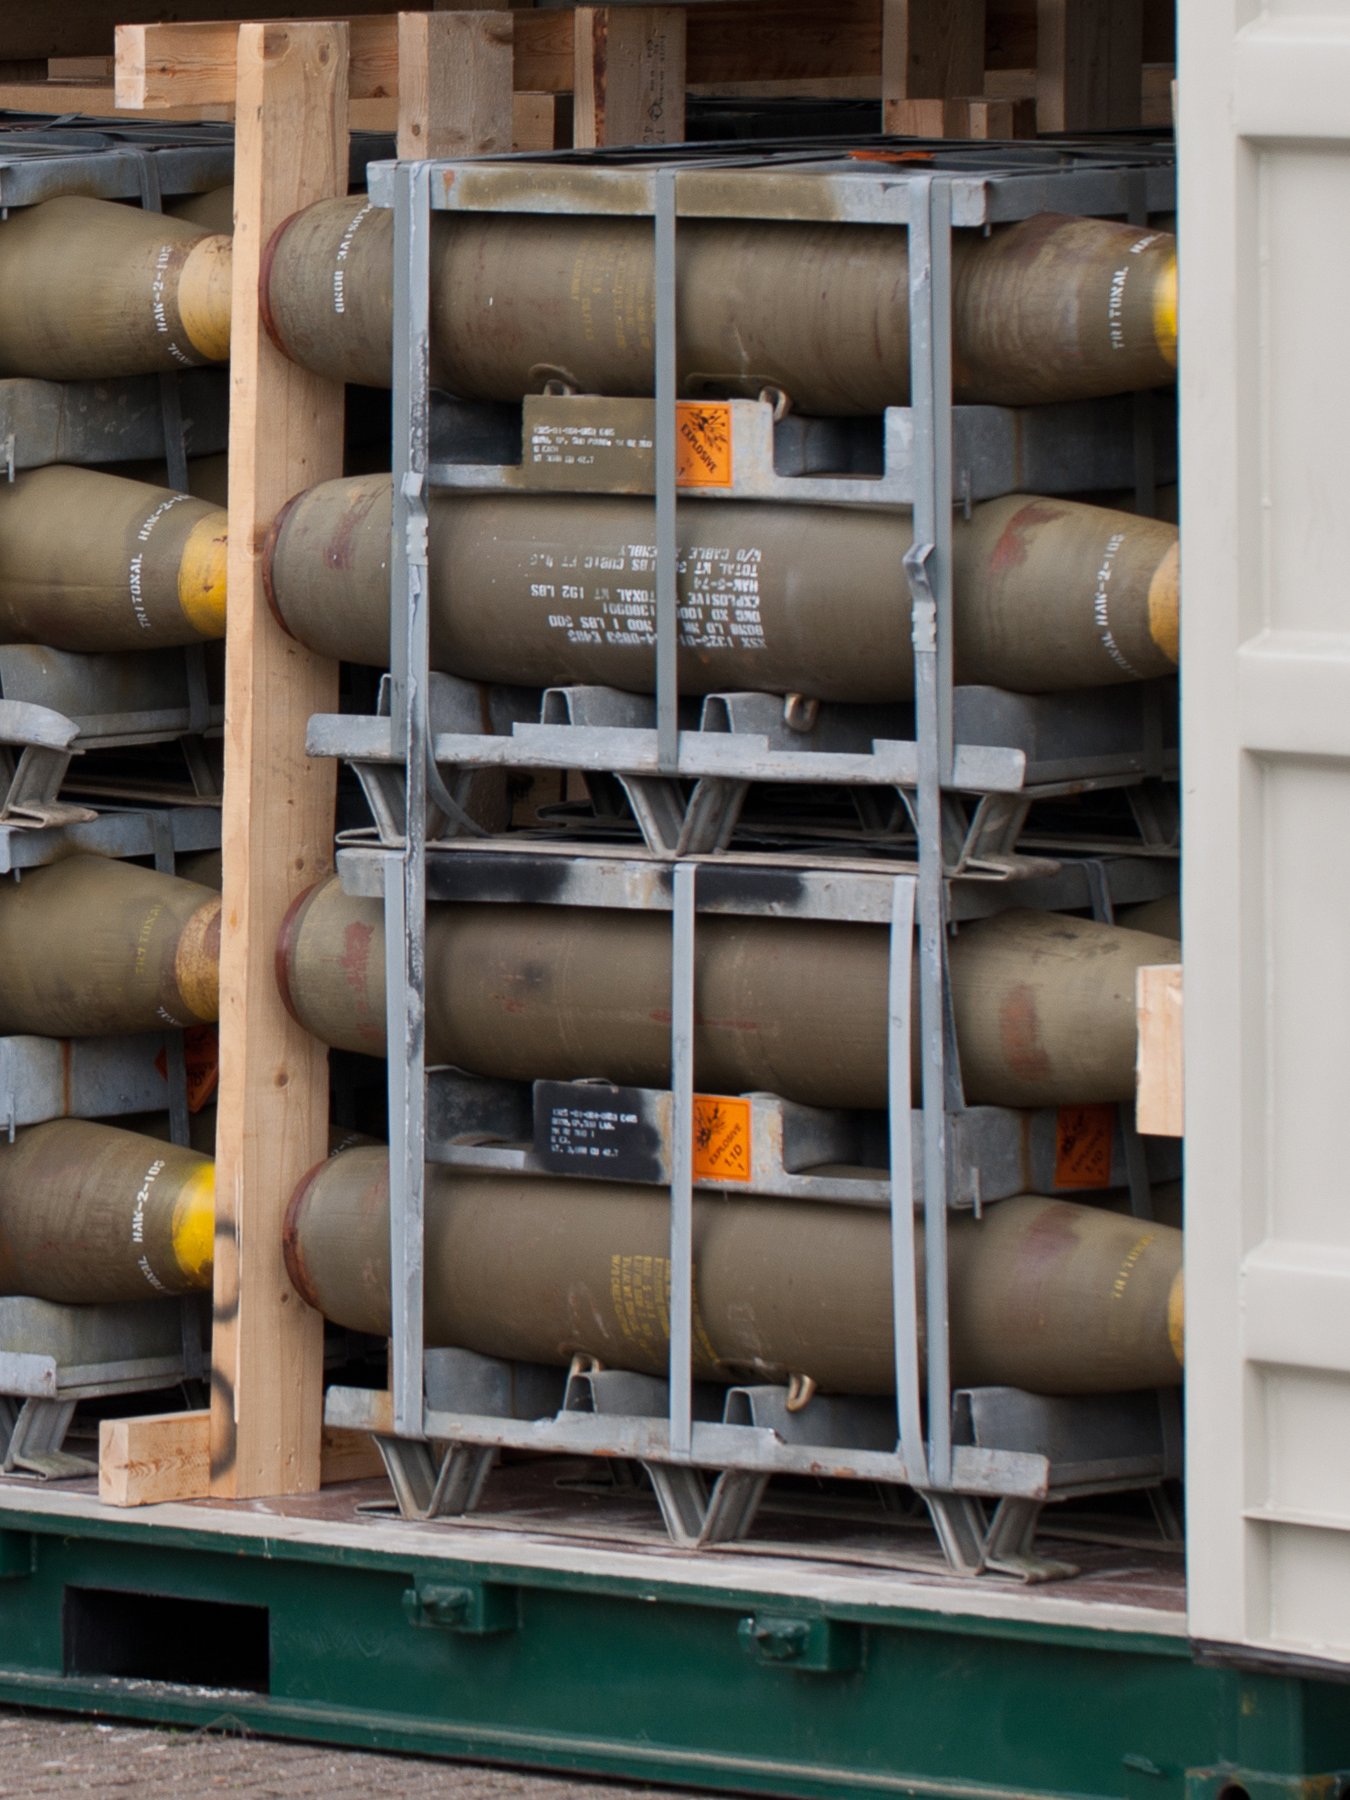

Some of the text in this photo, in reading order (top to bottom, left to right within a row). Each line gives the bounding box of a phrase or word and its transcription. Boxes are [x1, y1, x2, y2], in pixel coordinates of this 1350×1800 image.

[680, 423, 718, 474] EXPLOSIVE
[688, 547, 730, 560] CABLE
[584, 556, 625, 570] CUBIC
[719, 562, 758, 577] TOTAL
[531, 584, 555, 598] LBS
[562, 585, 584, 599] 192
[688, 593, 761, 608] EXPLOSIVE
[580, 617, 605, 629] LBS
[730, 623, 763, 636] BOMB
[709, 1122, 743, 1165] EXPLOSIVE
